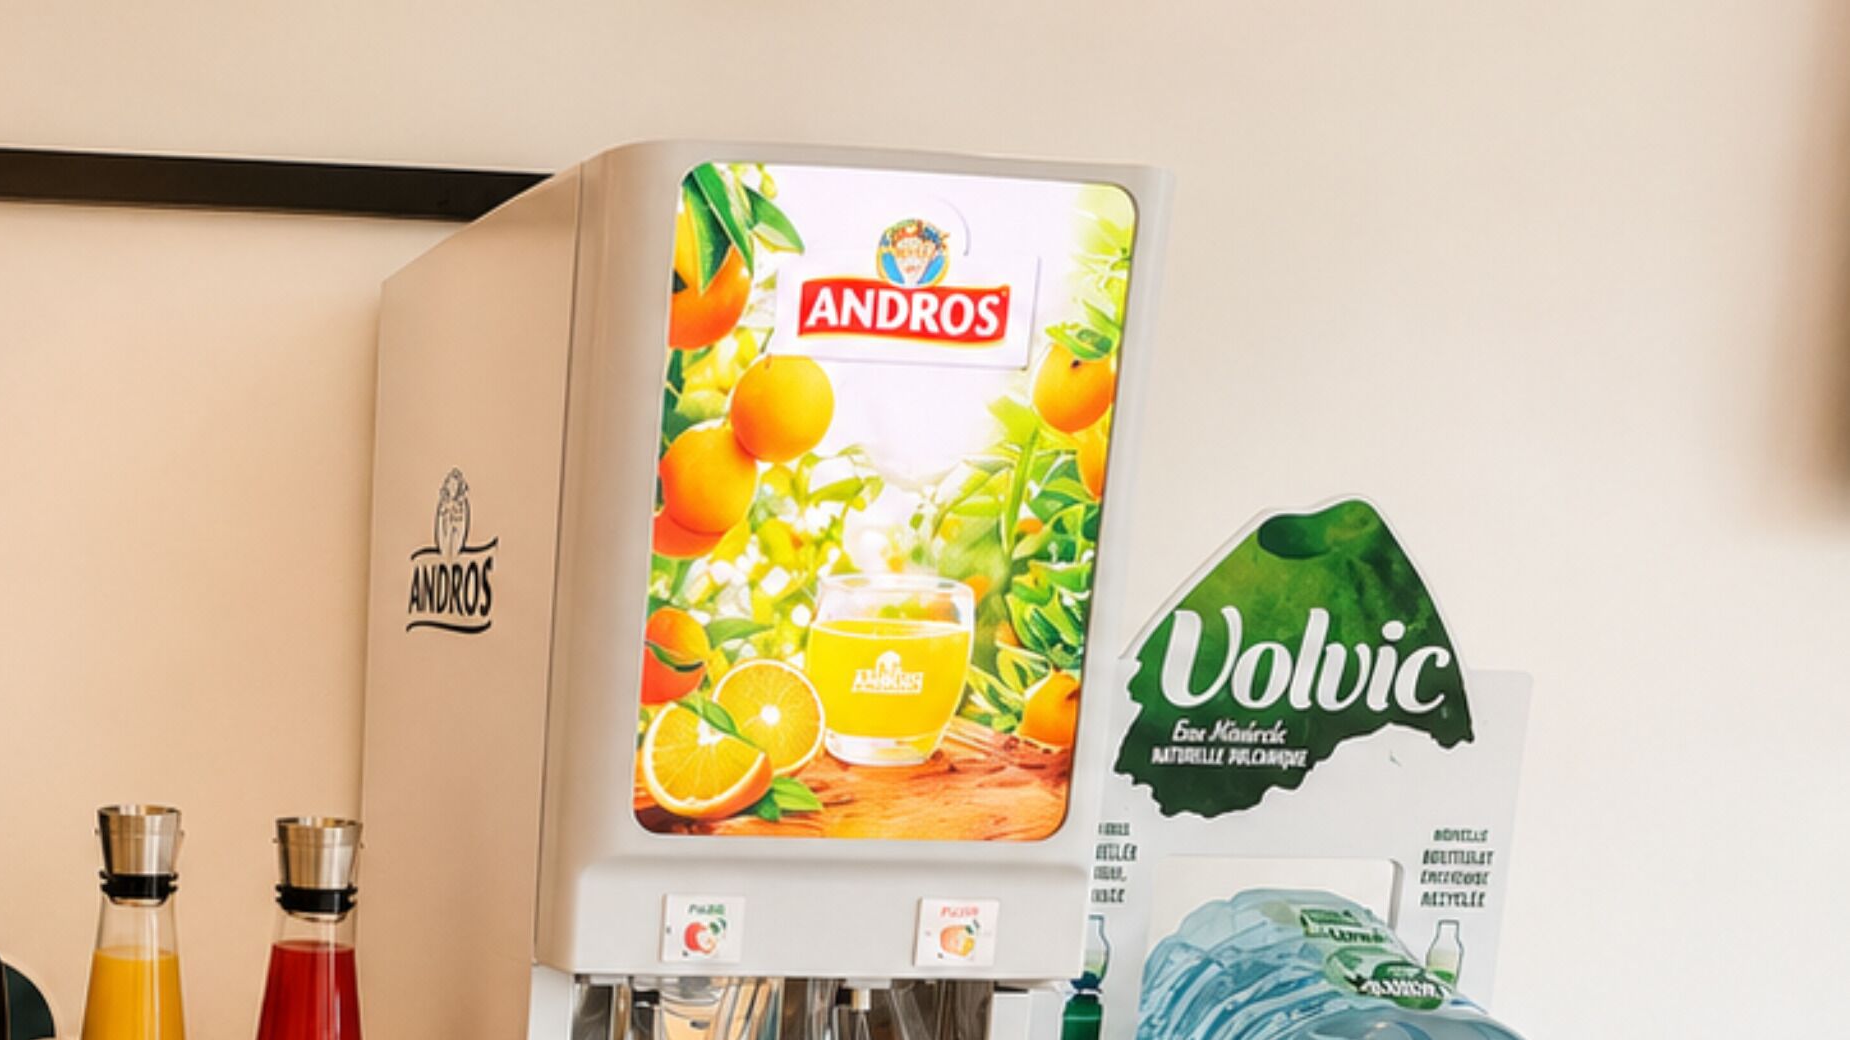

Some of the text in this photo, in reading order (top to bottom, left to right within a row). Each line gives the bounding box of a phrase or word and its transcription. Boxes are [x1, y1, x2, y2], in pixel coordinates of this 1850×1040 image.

[805, 286, 1002, 337] ANDROS
[408, 556, 494, 616] ANDROS
[1161, 606, 1450, 713] Volvic
